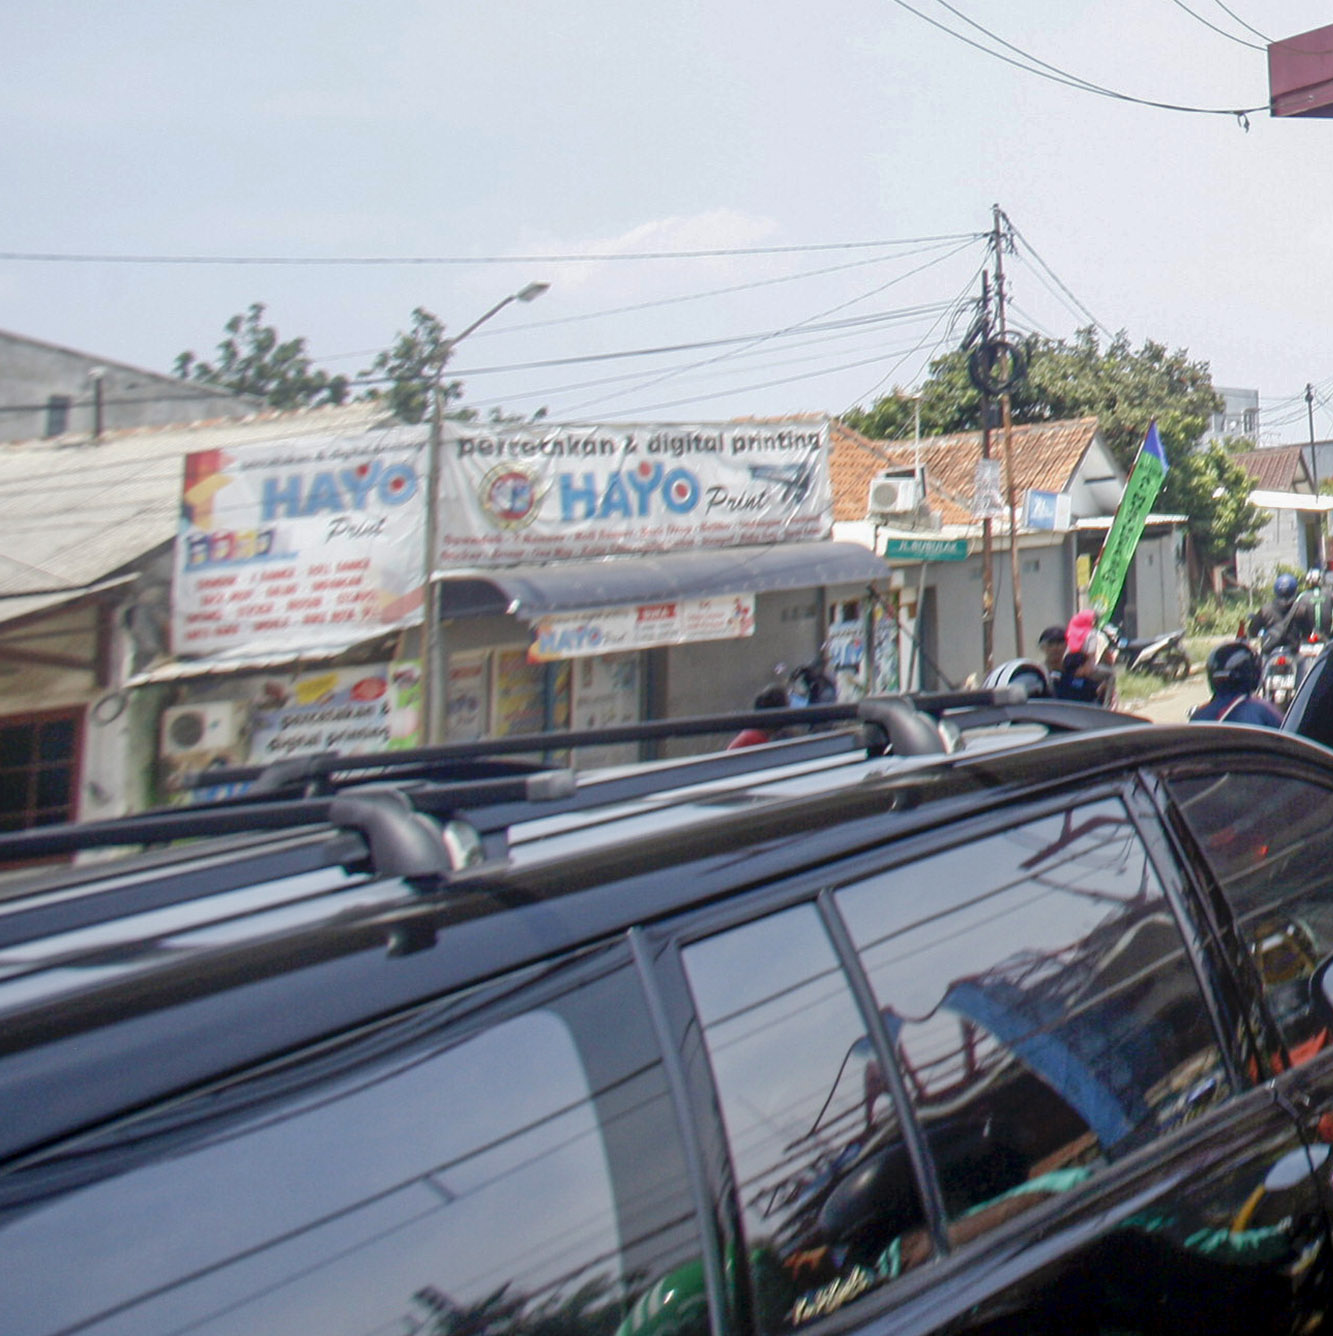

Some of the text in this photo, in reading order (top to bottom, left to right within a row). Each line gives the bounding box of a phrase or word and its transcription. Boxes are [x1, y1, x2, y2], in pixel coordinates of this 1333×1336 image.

[647, 431, 724, 458] digital
[731, 429, 822, 456] printing
[262, 459, 418, 522] HAYO
[559, 460, 700, 522] HAYO
[705, 485, 768, 516] Print
[325, 514, 387, 545] Print
[539, 623, 602, 654] HAYO
